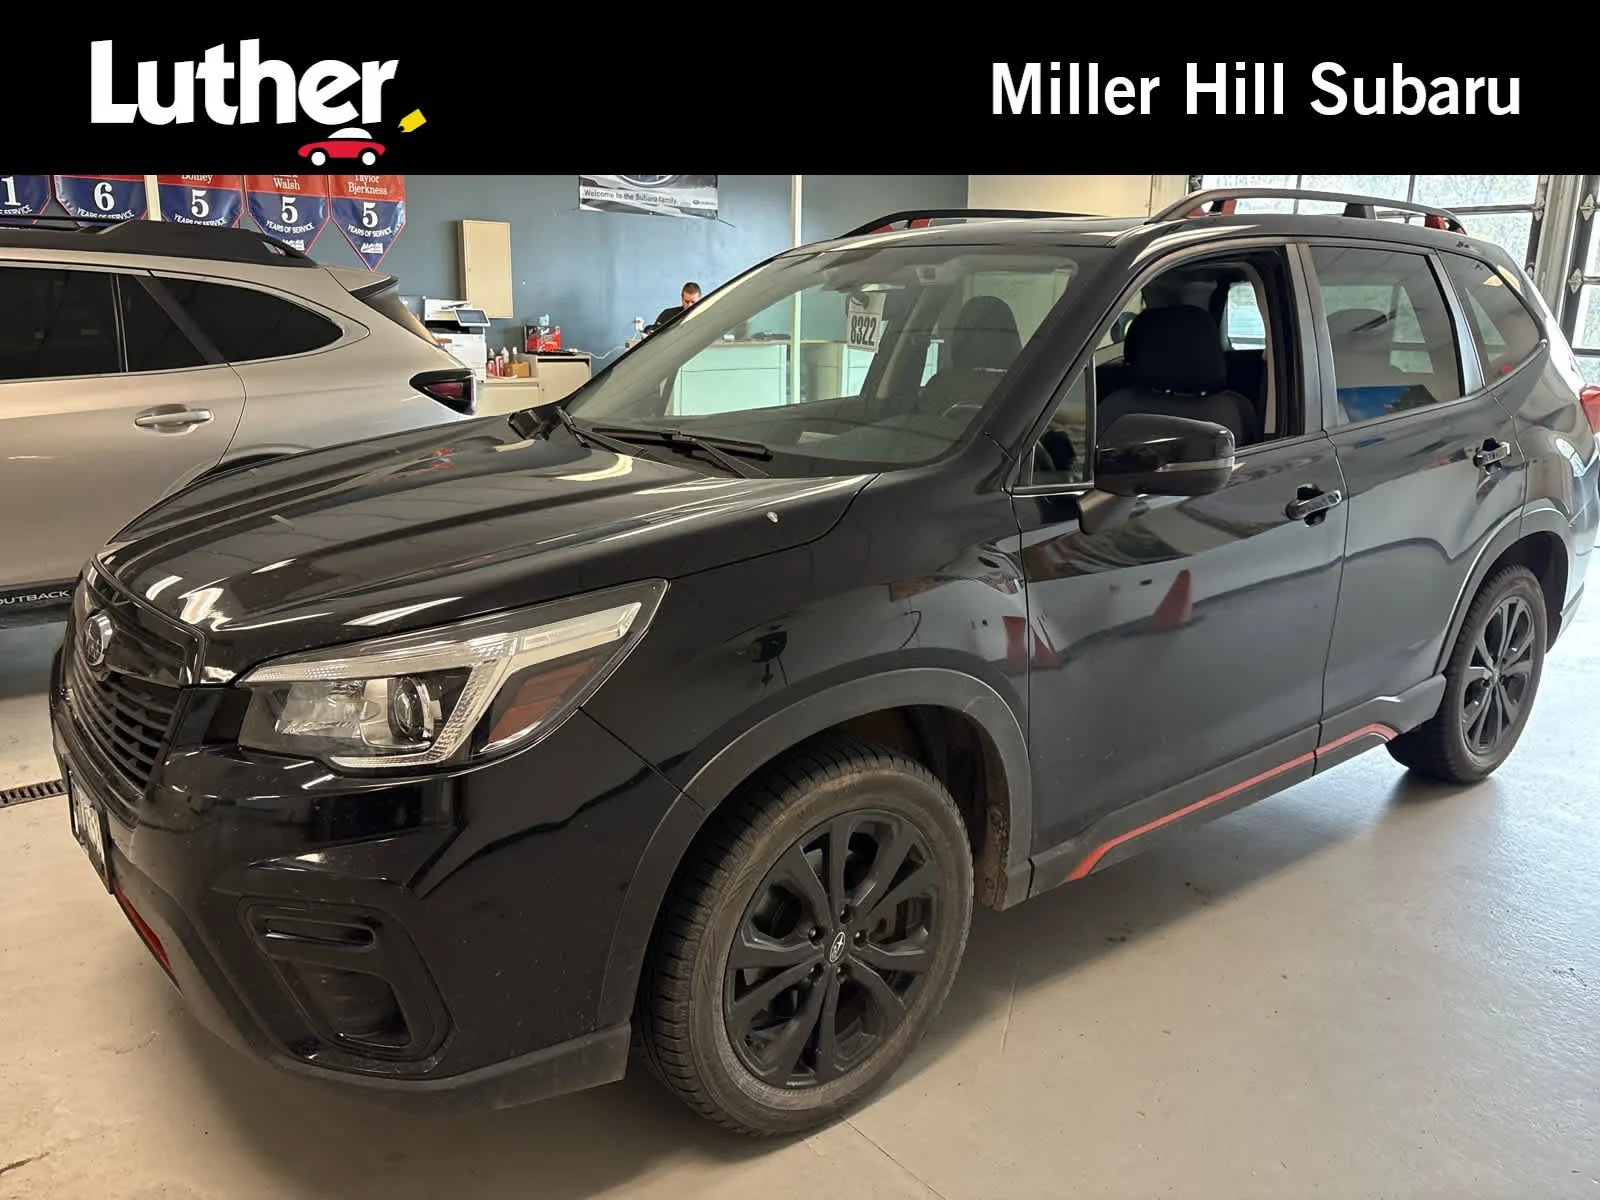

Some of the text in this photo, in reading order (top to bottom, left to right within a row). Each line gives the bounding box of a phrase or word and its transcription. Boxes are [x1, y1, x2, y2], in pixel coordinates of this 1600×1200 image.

[94, 182, 115, 212] 6
[273, 177, 301, 190] Walsh
[583, 189, 615, 200] Welcome
[623, 192, 634, 200] the
[191, 189, 209, 218] 5
[281, 196, 298, 224] 5
[362, 201, 379, 228] 5
[266, 219, 283, 232] YEARS
[292, 222, 316, 234] SERVICE
[347, 223, 365, 236] YEARS
[372, 226, 394, 237] SERVICE
[850, 315, 877, 346] 8322
